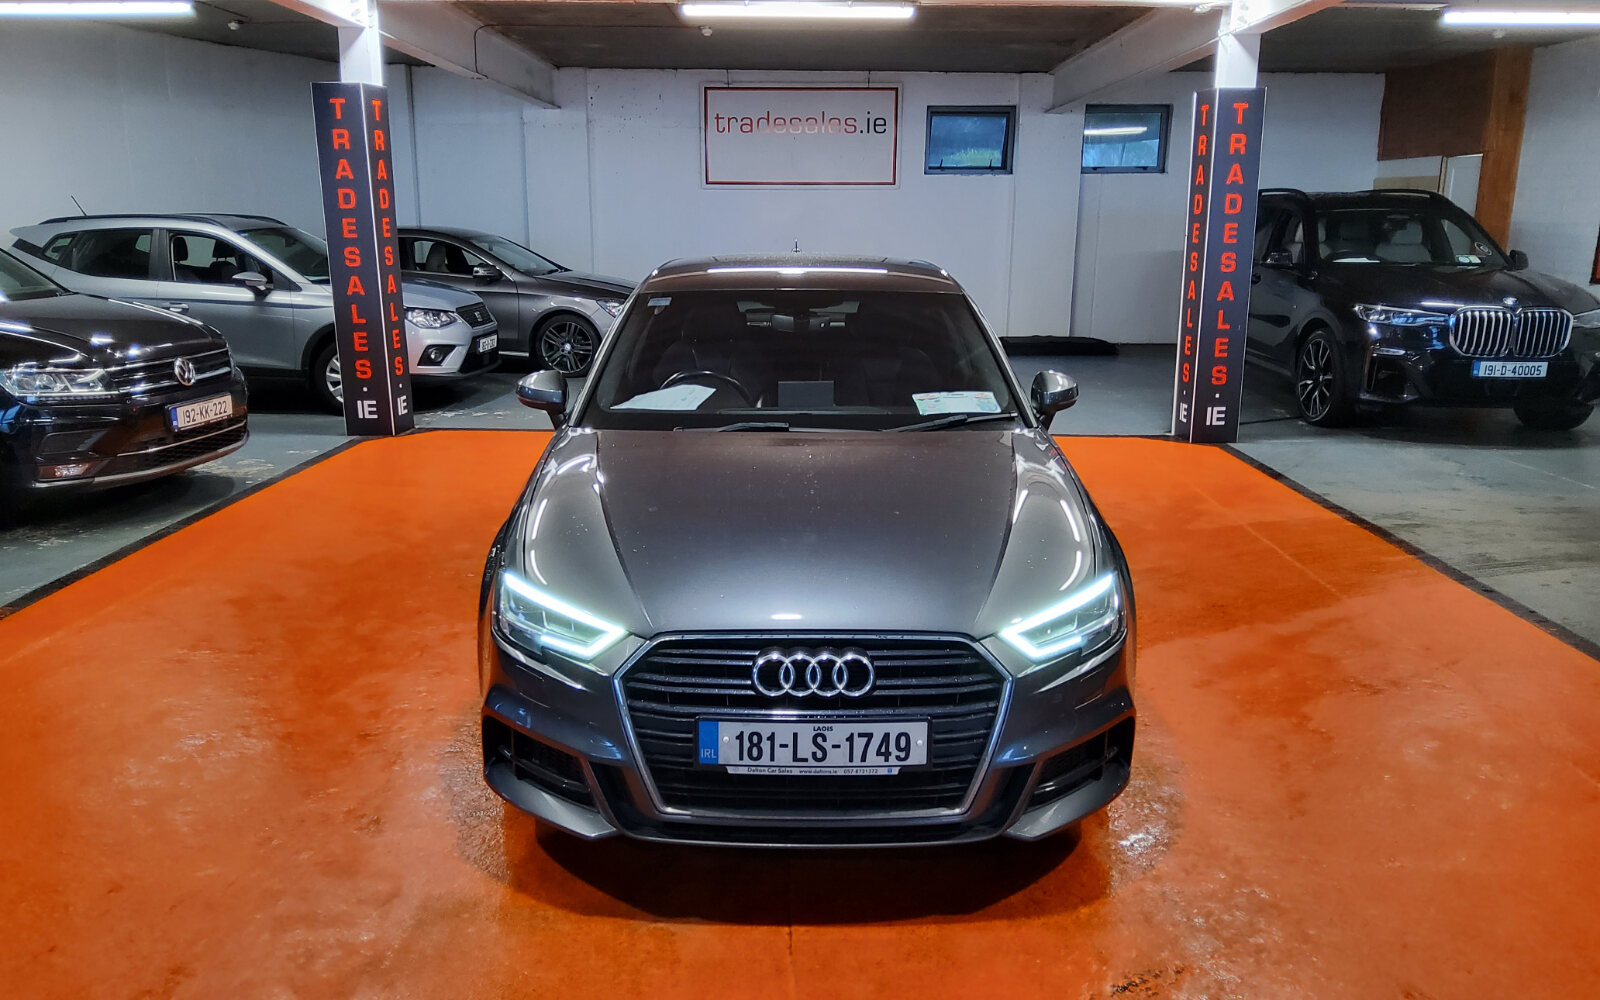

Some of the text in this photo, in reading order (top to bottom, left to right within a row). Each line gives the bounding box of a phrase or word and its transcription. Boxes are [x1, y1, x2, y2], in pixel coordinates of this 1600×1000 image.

[714, 111, 887, 134] tradesales.ie
[1484, 364, 1542, 376] 191-D-40005
[183, 400, 227, 424] 192-KK-222
[700, 747, 717, 759] IRL
[735, 731, 911, 763] 181-LS-1749
